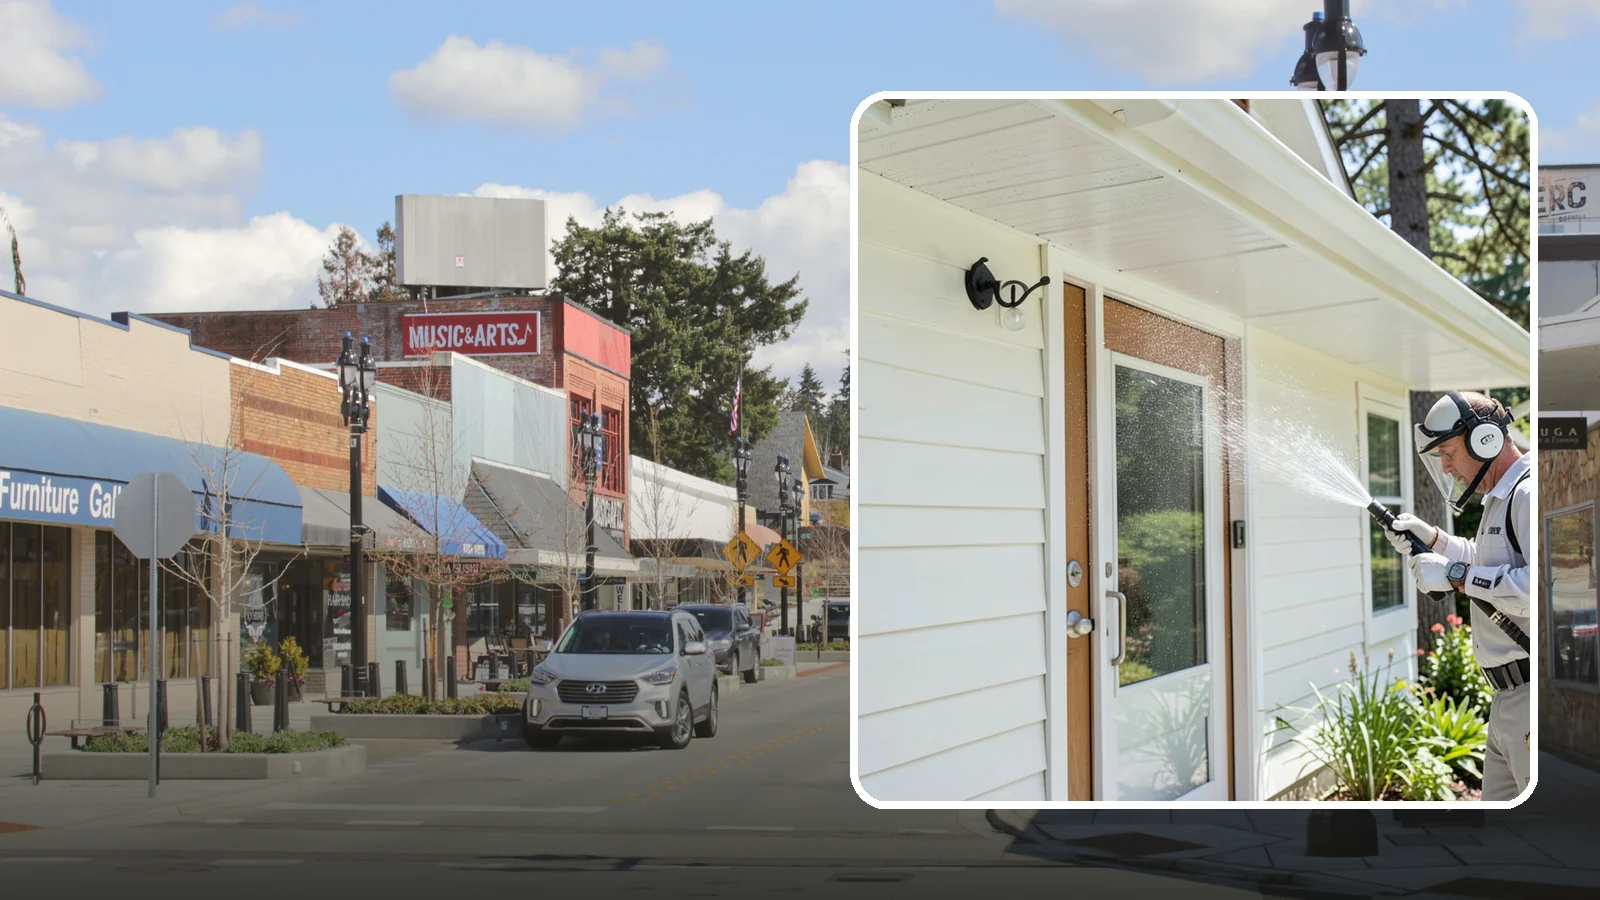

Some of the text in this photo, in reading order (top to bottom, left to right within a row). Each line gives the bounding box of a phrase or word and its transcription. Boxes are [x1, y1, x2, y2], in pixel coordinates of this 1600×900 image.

[409, 323, 519, 349] MUSIC&ARTS
[0, 471, 79, 516] Furniture
[453, 563, 479, 574] SUSHI
